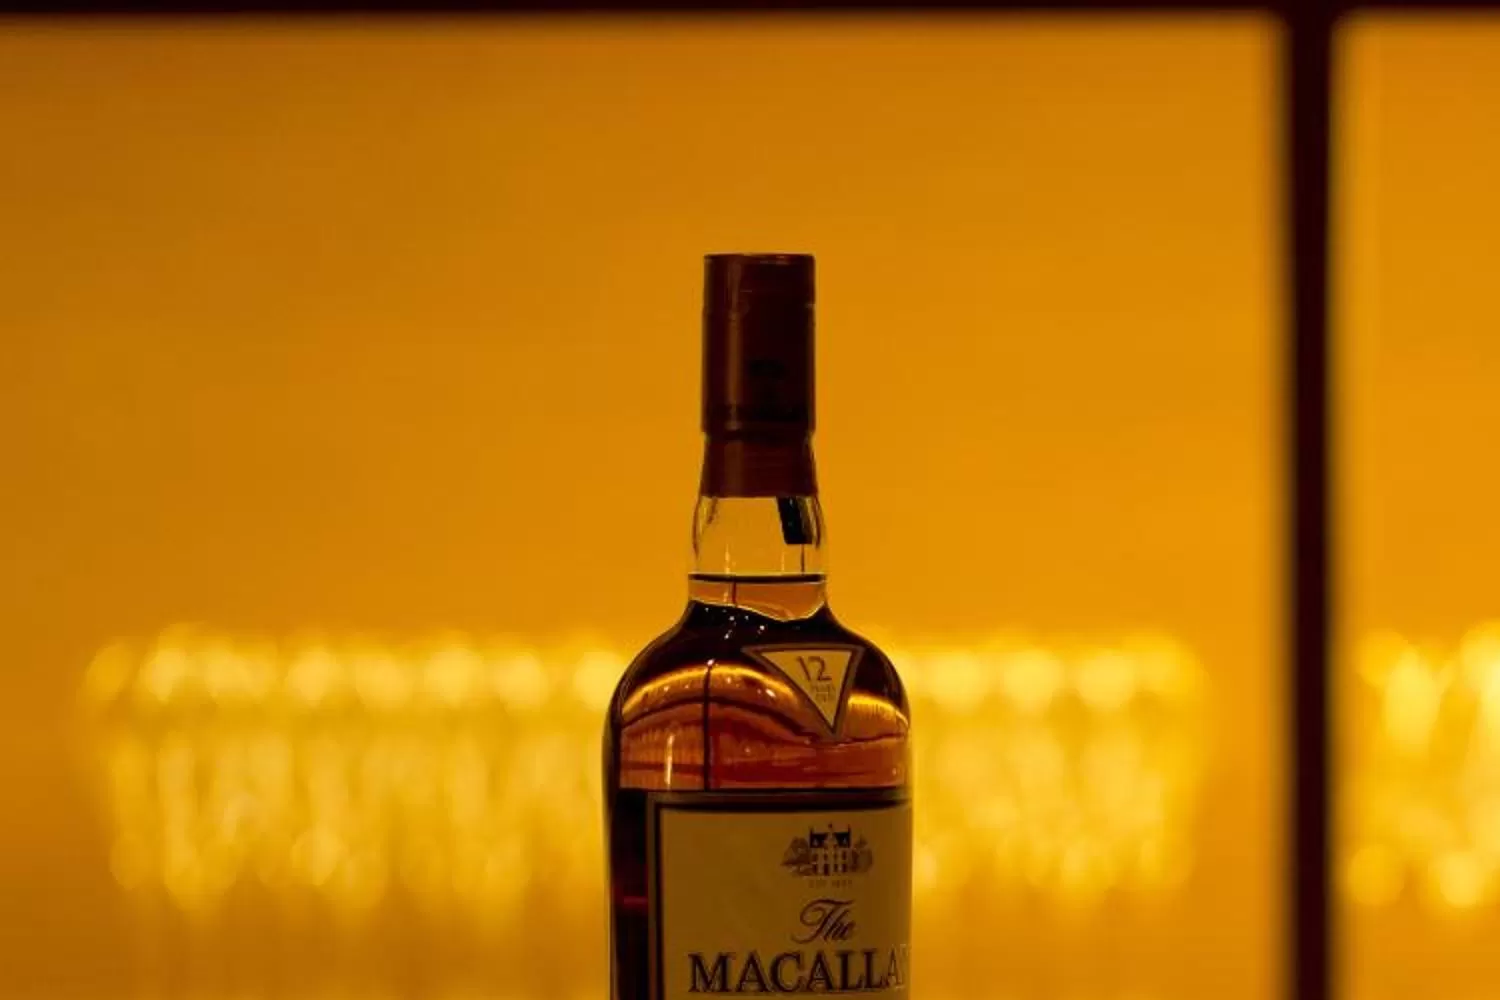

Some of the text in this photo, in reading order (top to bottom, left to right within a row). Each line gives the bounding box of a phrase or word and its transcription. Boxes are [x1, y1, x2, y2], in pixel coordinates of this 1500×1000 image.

[795, 655, 833, 682] 12
[791, 898, 856, 945] The
[687, 946, 910, 994] MACALLA
